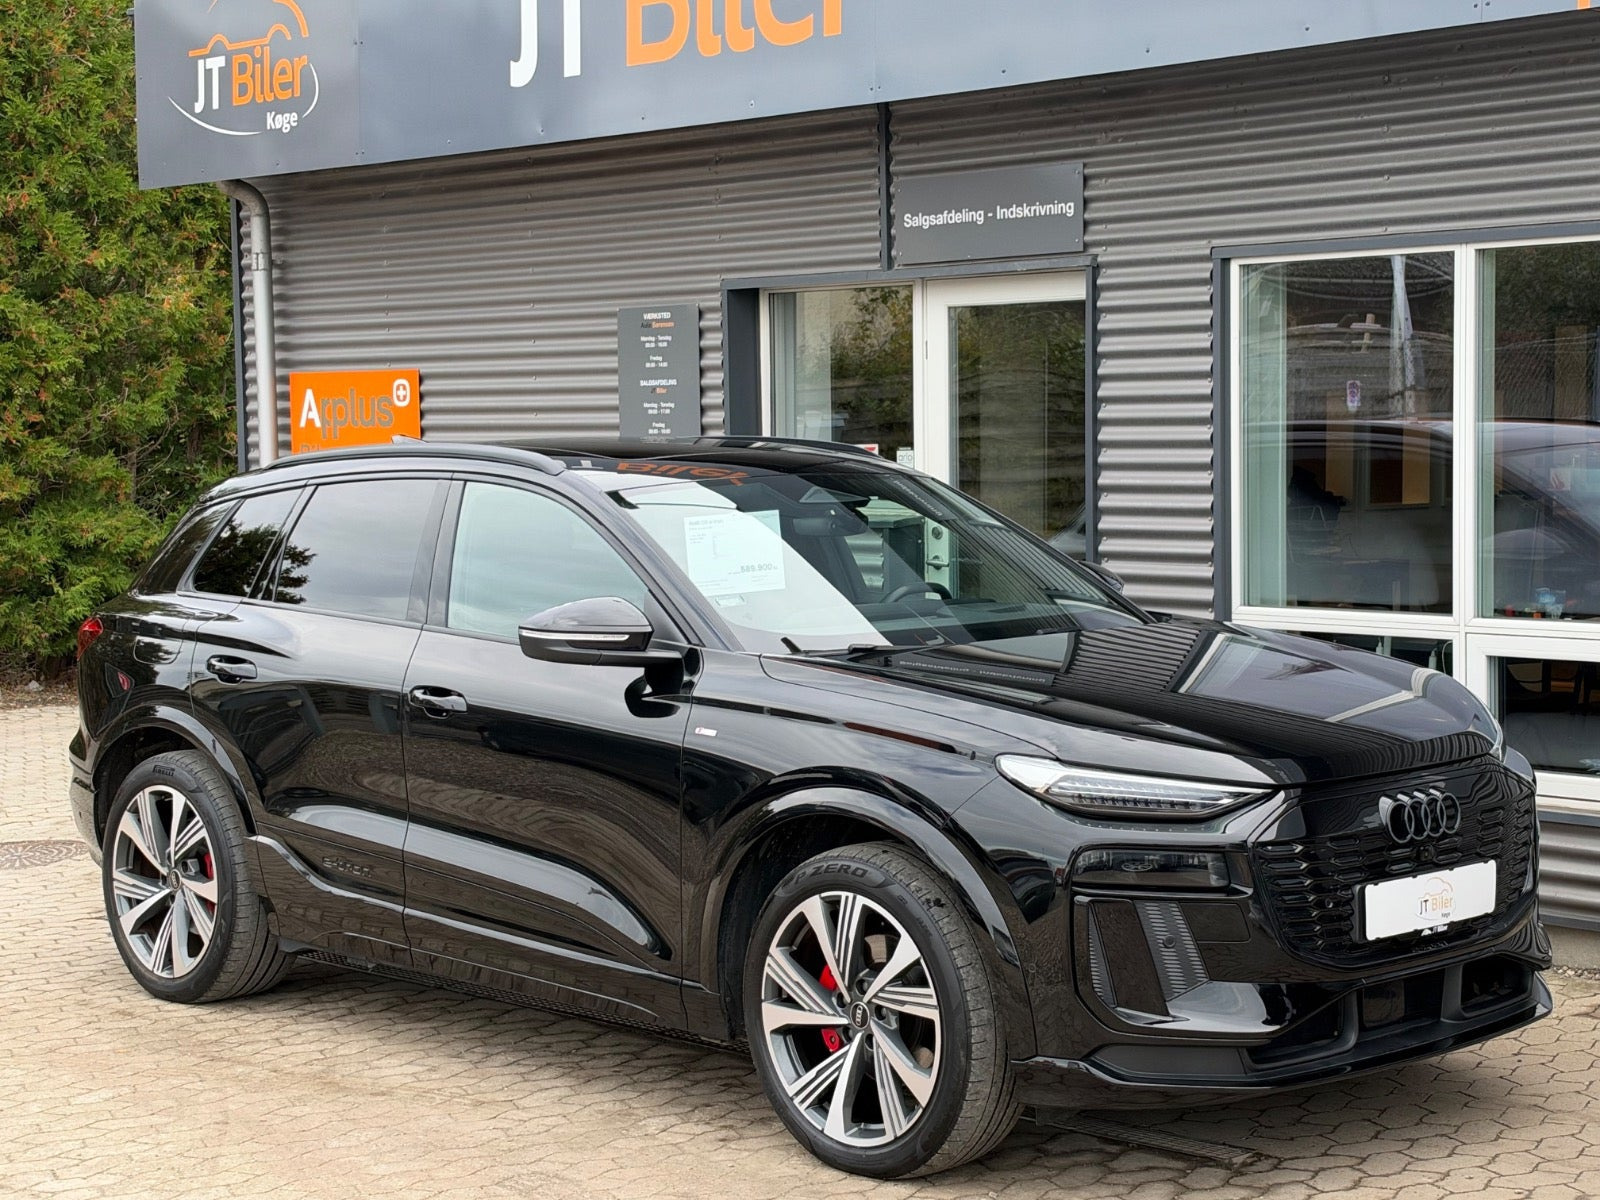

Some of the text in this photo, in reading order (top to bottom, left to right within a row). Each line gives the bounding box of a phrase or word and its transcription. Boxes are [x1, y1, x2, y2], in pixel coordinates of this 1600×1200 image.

[194, 46, 308, 114] JT Biler
[266, 111, 299, 133] Køge
[903, 208, 984, 229] Salgsafdeling
[996, 200, 1075, 220] Indskrivning
[808, 863, 868, 878] ZERO
[1420, 896, 1453, 915] JT Biler
